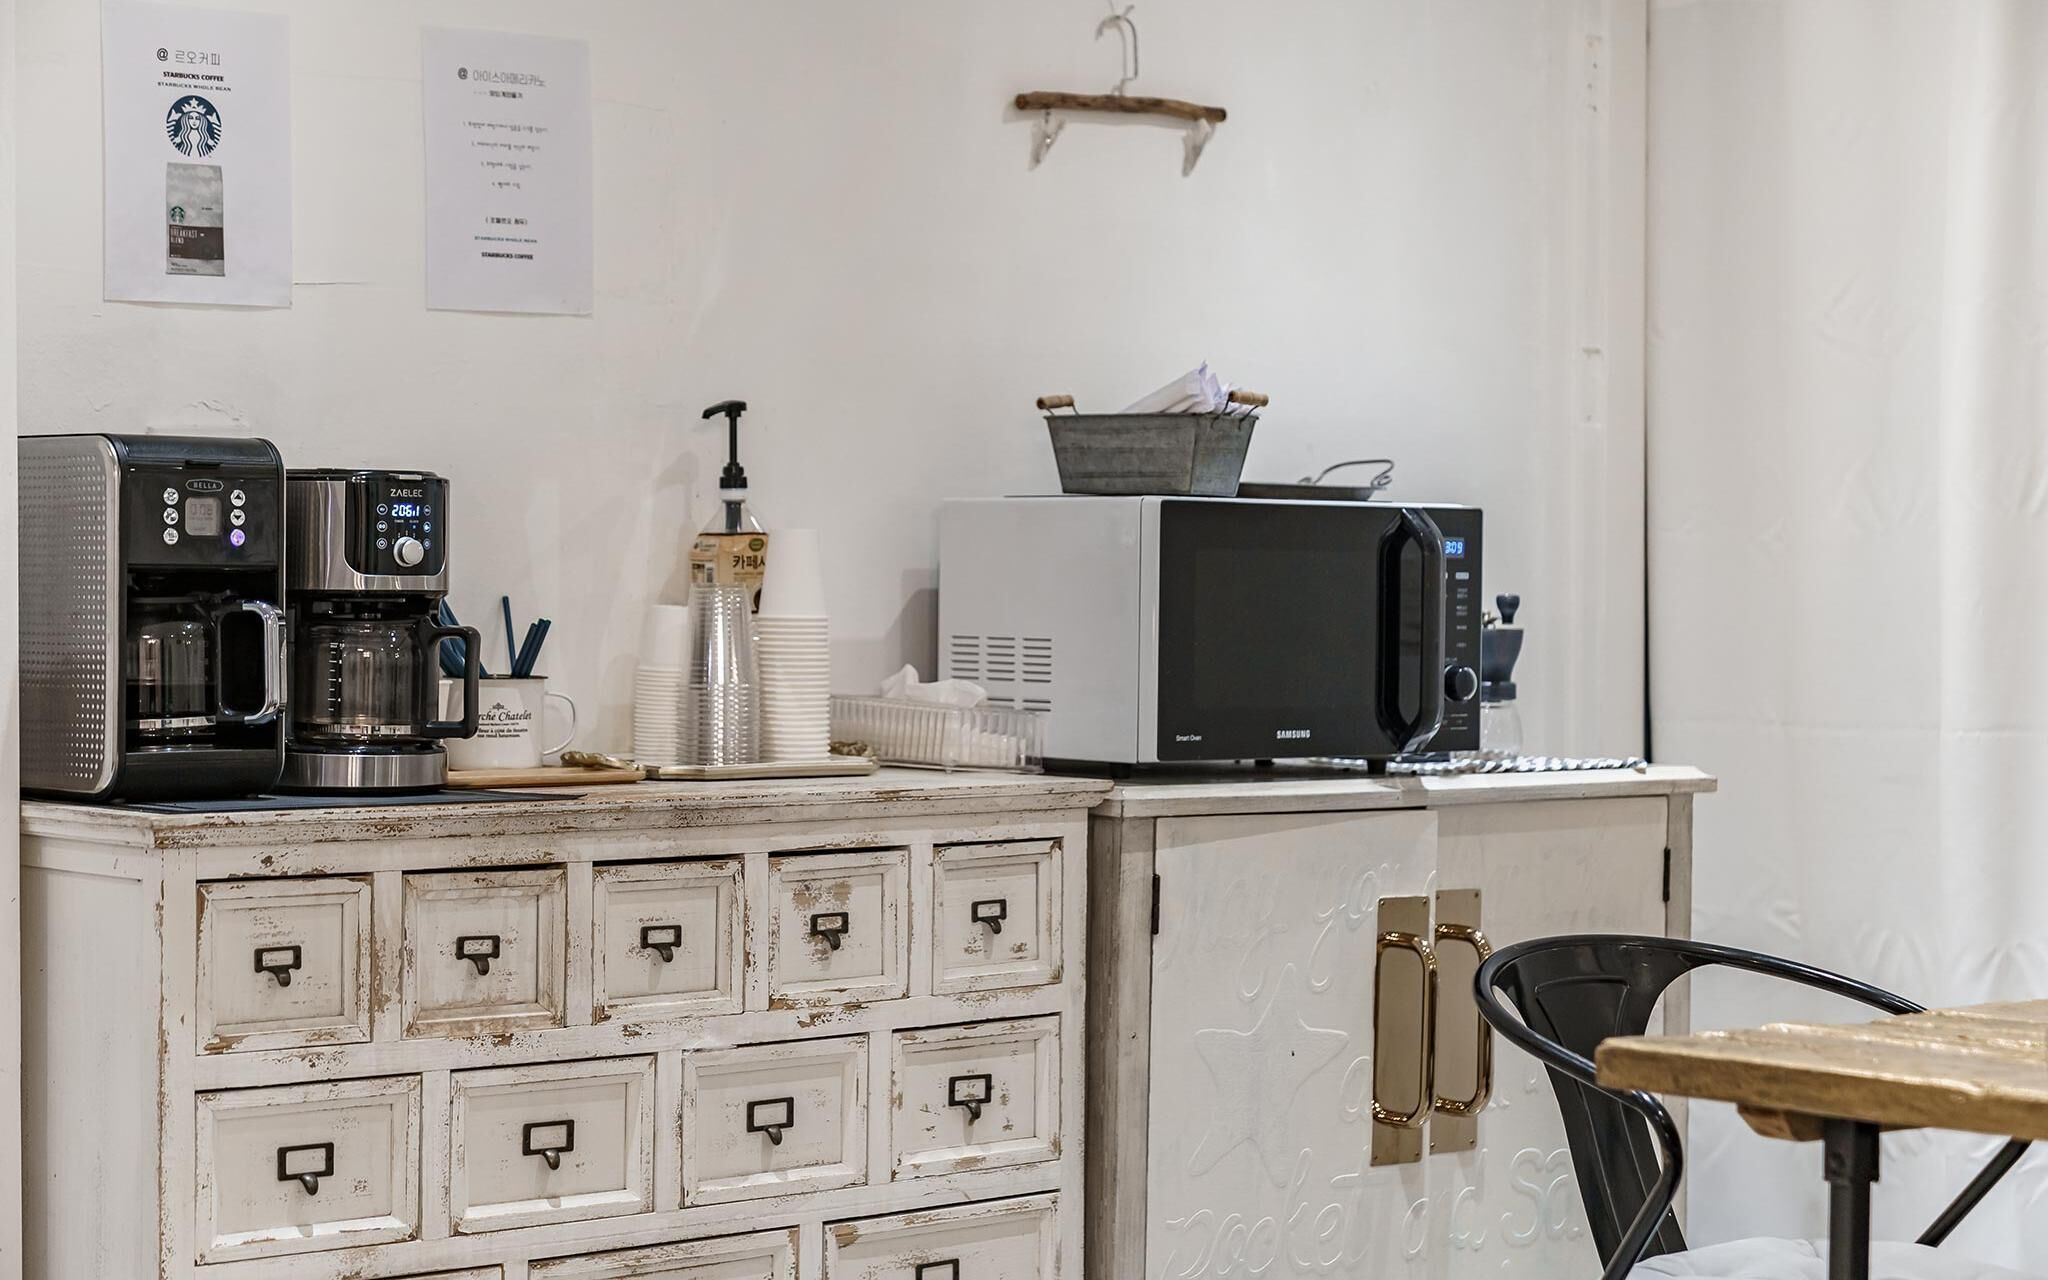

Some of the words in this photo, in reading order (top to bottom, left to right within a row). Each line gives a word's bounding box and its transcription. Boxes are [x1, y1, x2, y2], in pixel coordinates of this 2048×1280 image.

[157, 48, 168, 62] @
[176, 50, 220, 66] 르오커피
[163, 72, 200, 80] STARBUCKS
[472, 70, 546, 87] 아이스아메리카노
[193, 481, 217, 489] BELLA
[390, 488, 423, 498] ZAELEC
[498, 710, 532, 722] Chatelet
[1276, 730, 1311, 739] SAMSUNG
